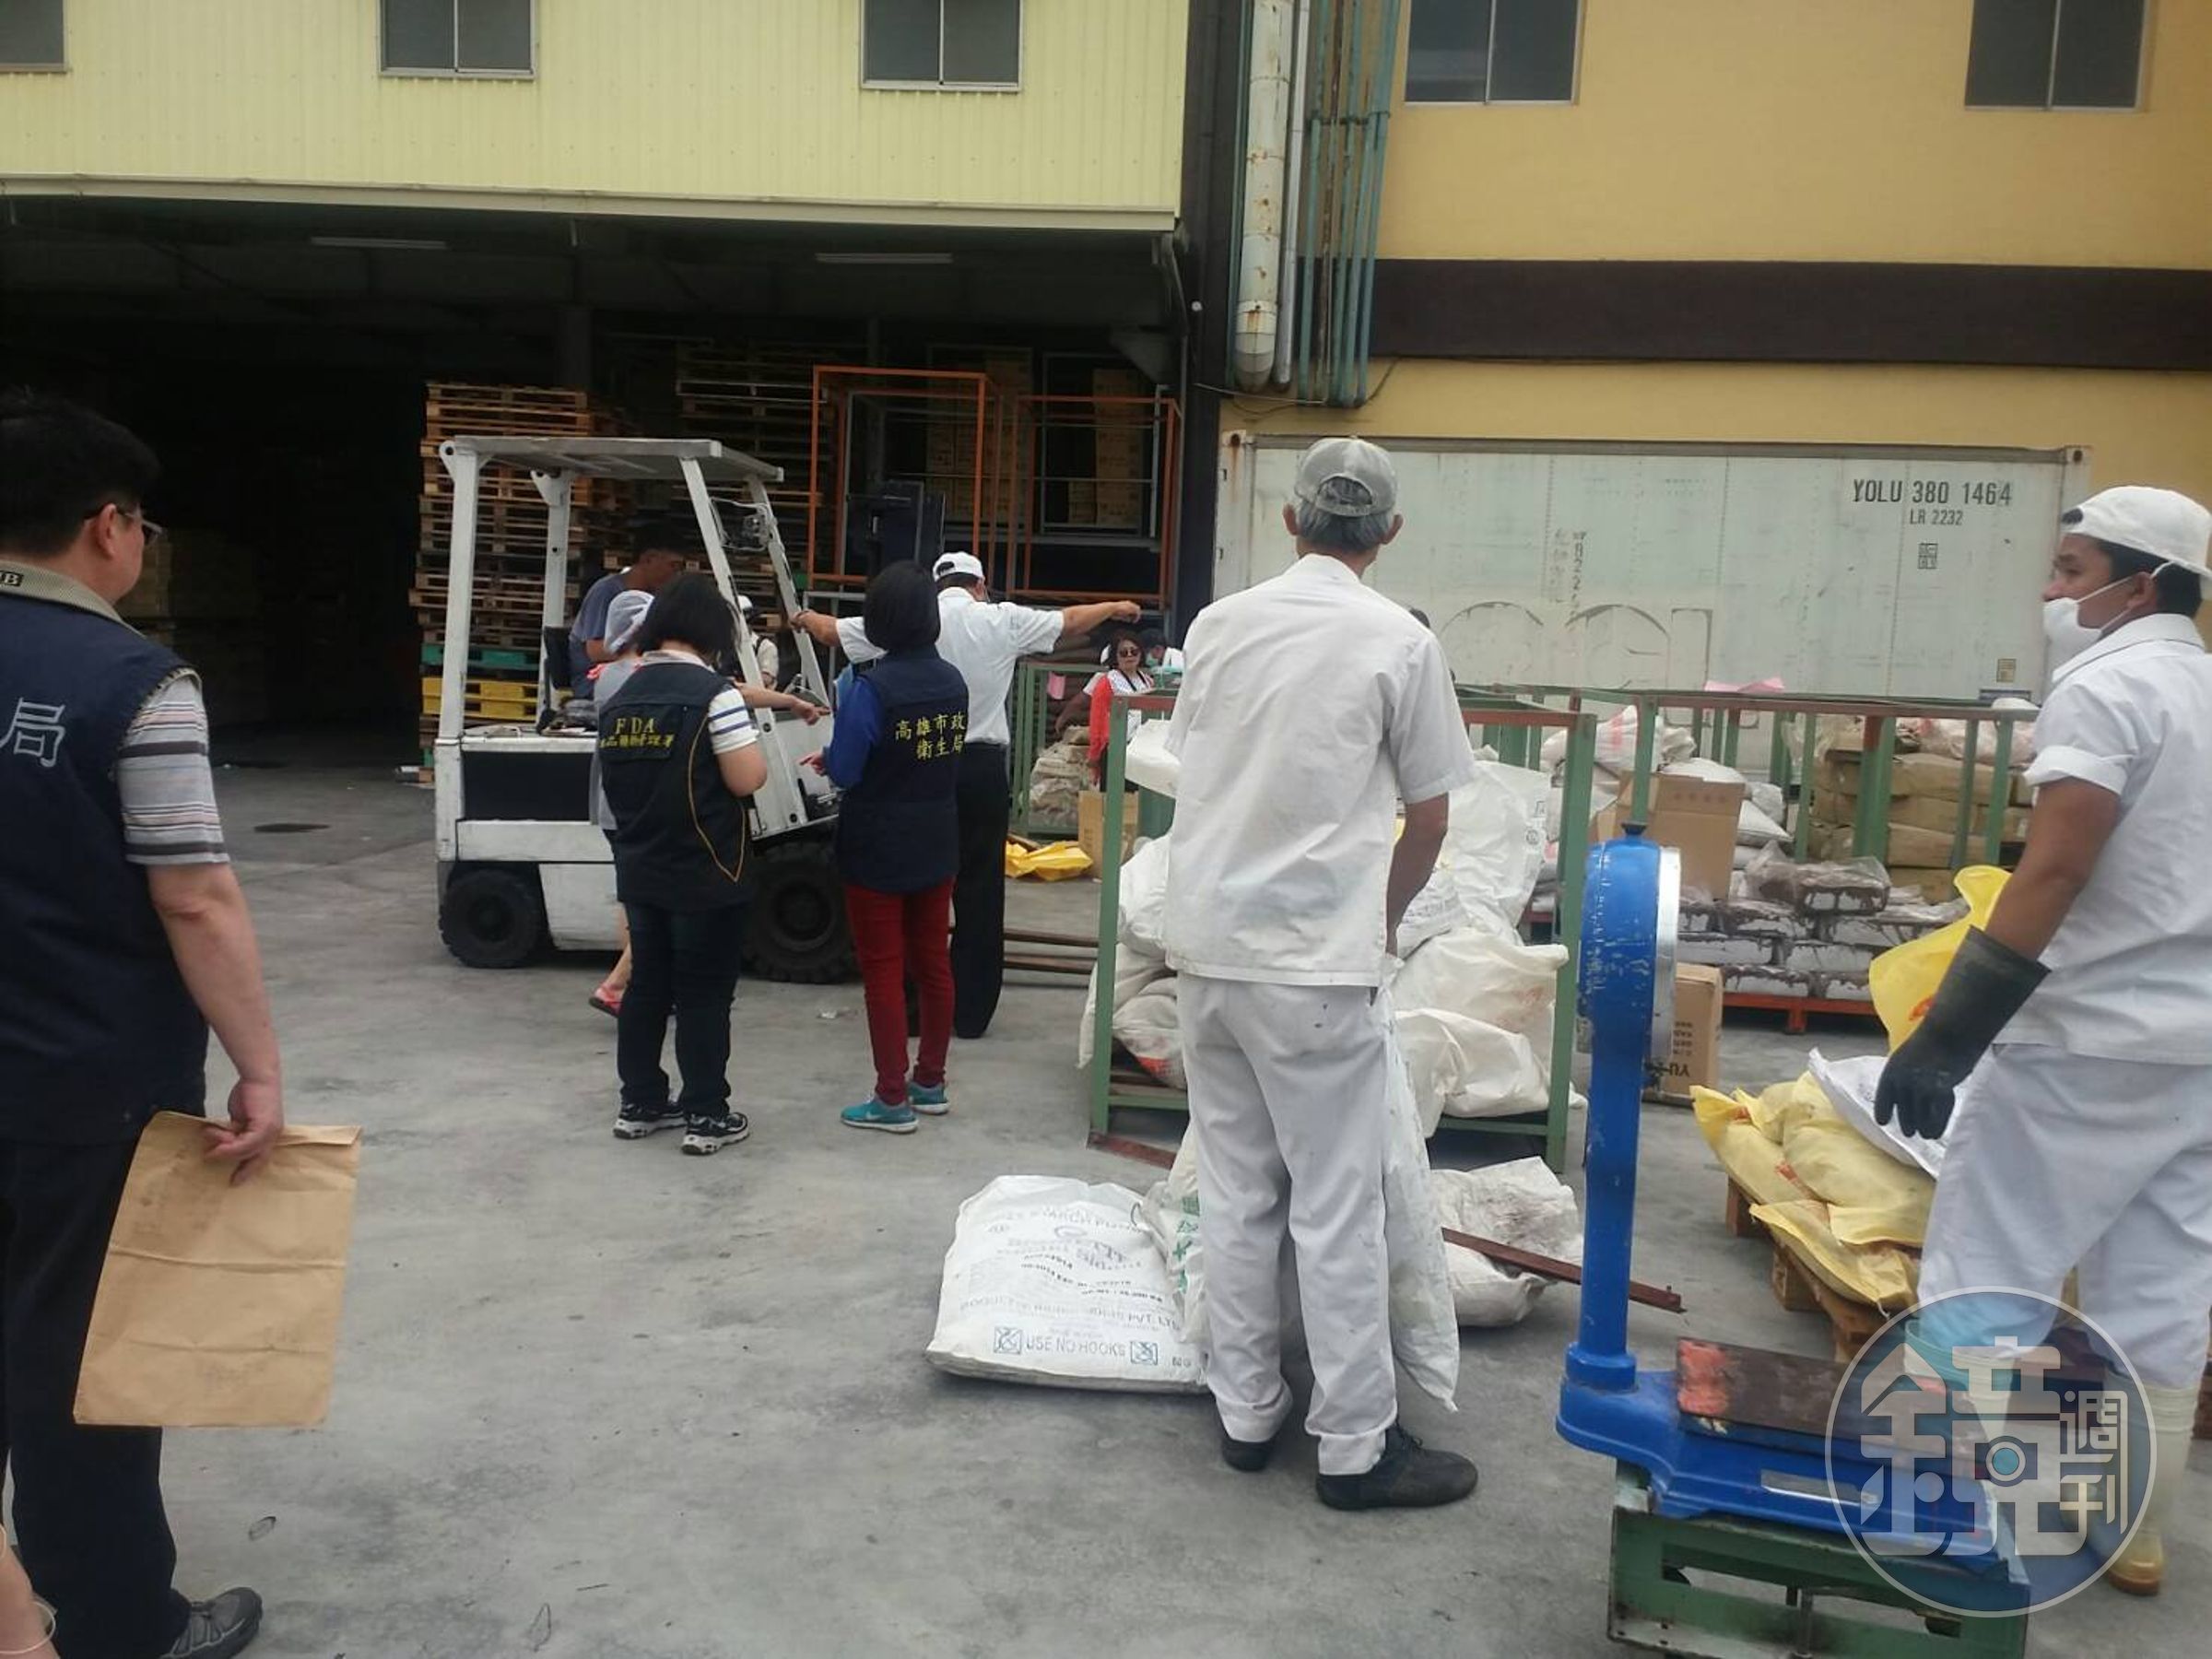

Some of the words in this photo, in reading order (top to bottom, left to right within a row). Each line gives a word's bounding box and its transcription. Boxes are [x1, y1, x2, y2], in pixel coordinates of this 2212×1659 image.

[1853, 478, 1902, 502] YOLU
[1912, 480, 1949, 504] 380
[1962, 482, 2012, 506] 1464
[1932, 511, 1963, 526] 2232
[0, 697, 65, 768] 局
[615, 717, 655, 735] FDA
[1027, 1335, 1053, 1351] USE
[1056, 1336, 1077, 1354] NO
[1078, 1340, 1126, 1357] HOOKS
